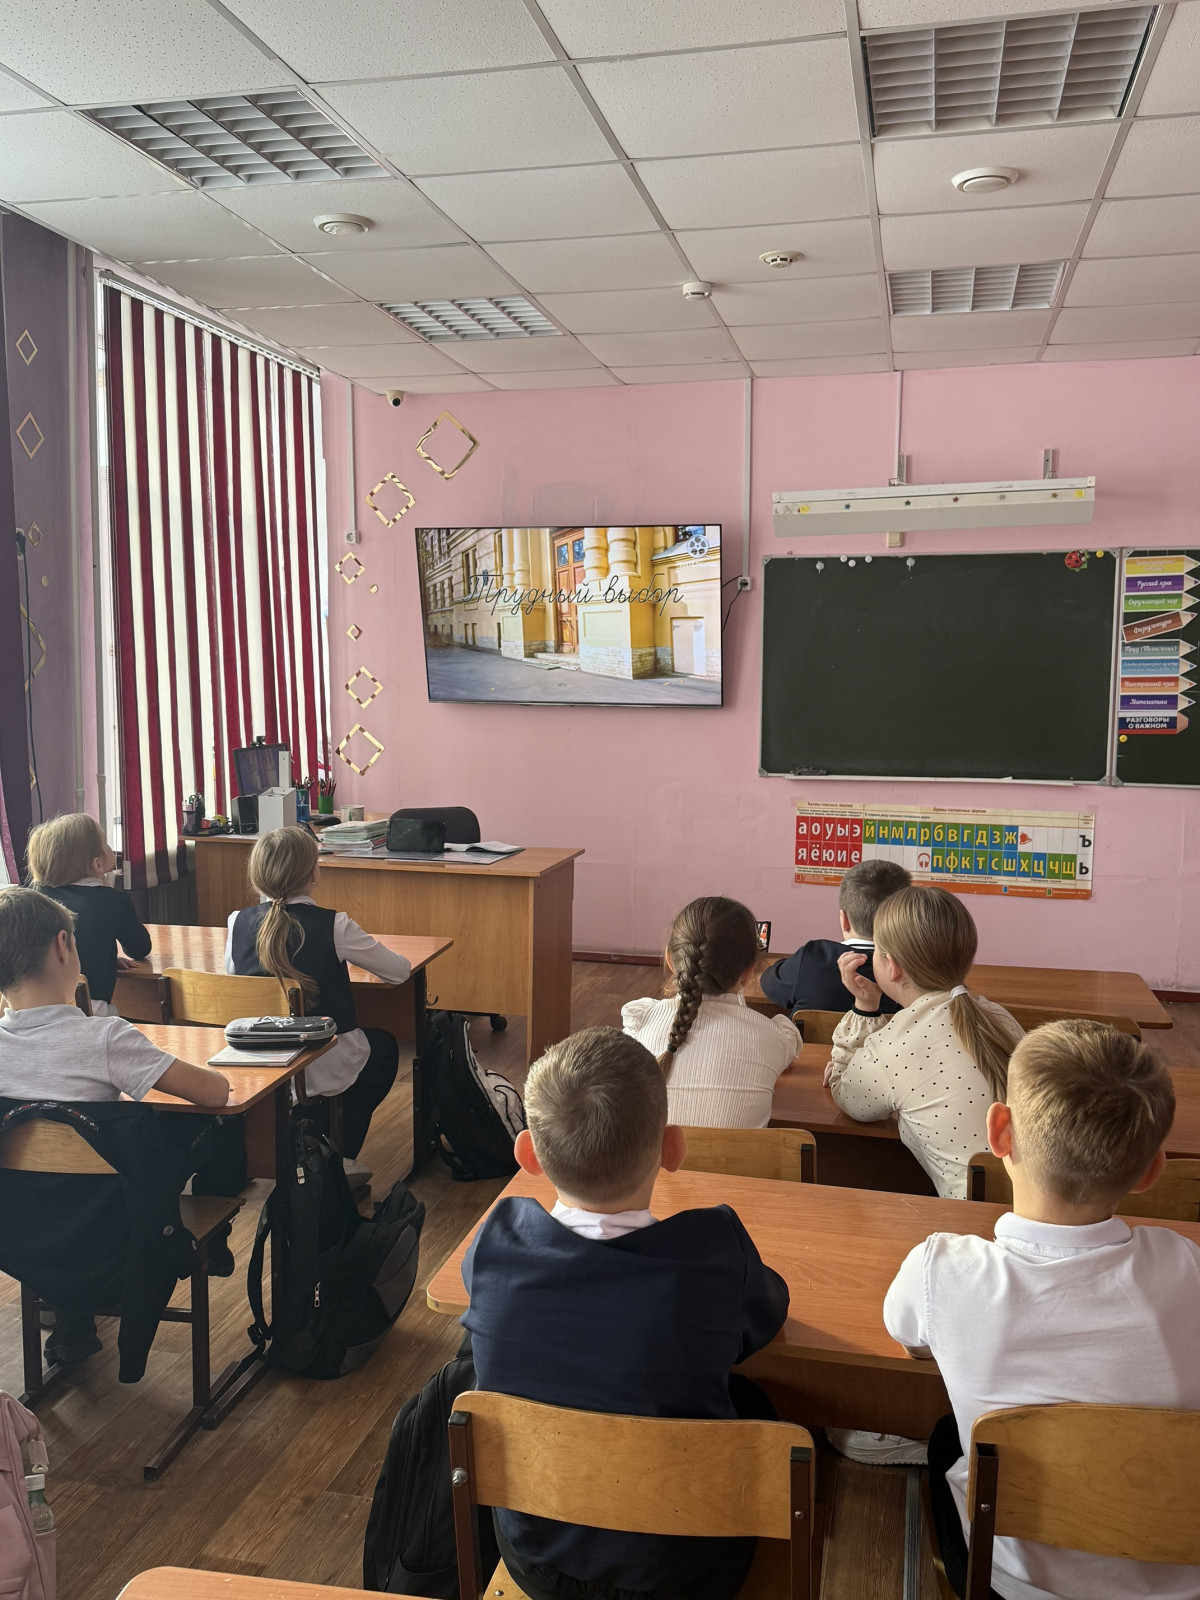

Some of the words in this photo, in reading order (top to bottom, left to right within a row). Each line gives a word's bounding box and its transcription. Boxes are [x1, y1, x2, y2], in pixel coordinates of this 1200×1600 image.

[1136, 580, 1158, 589] Русский
[1159, 580, 1173, 588] язык
[462, 574, 593, 616] Трудный
[602, 573, 684, 616] выбор
[1133, 619, 1172, 634] Физкультура
